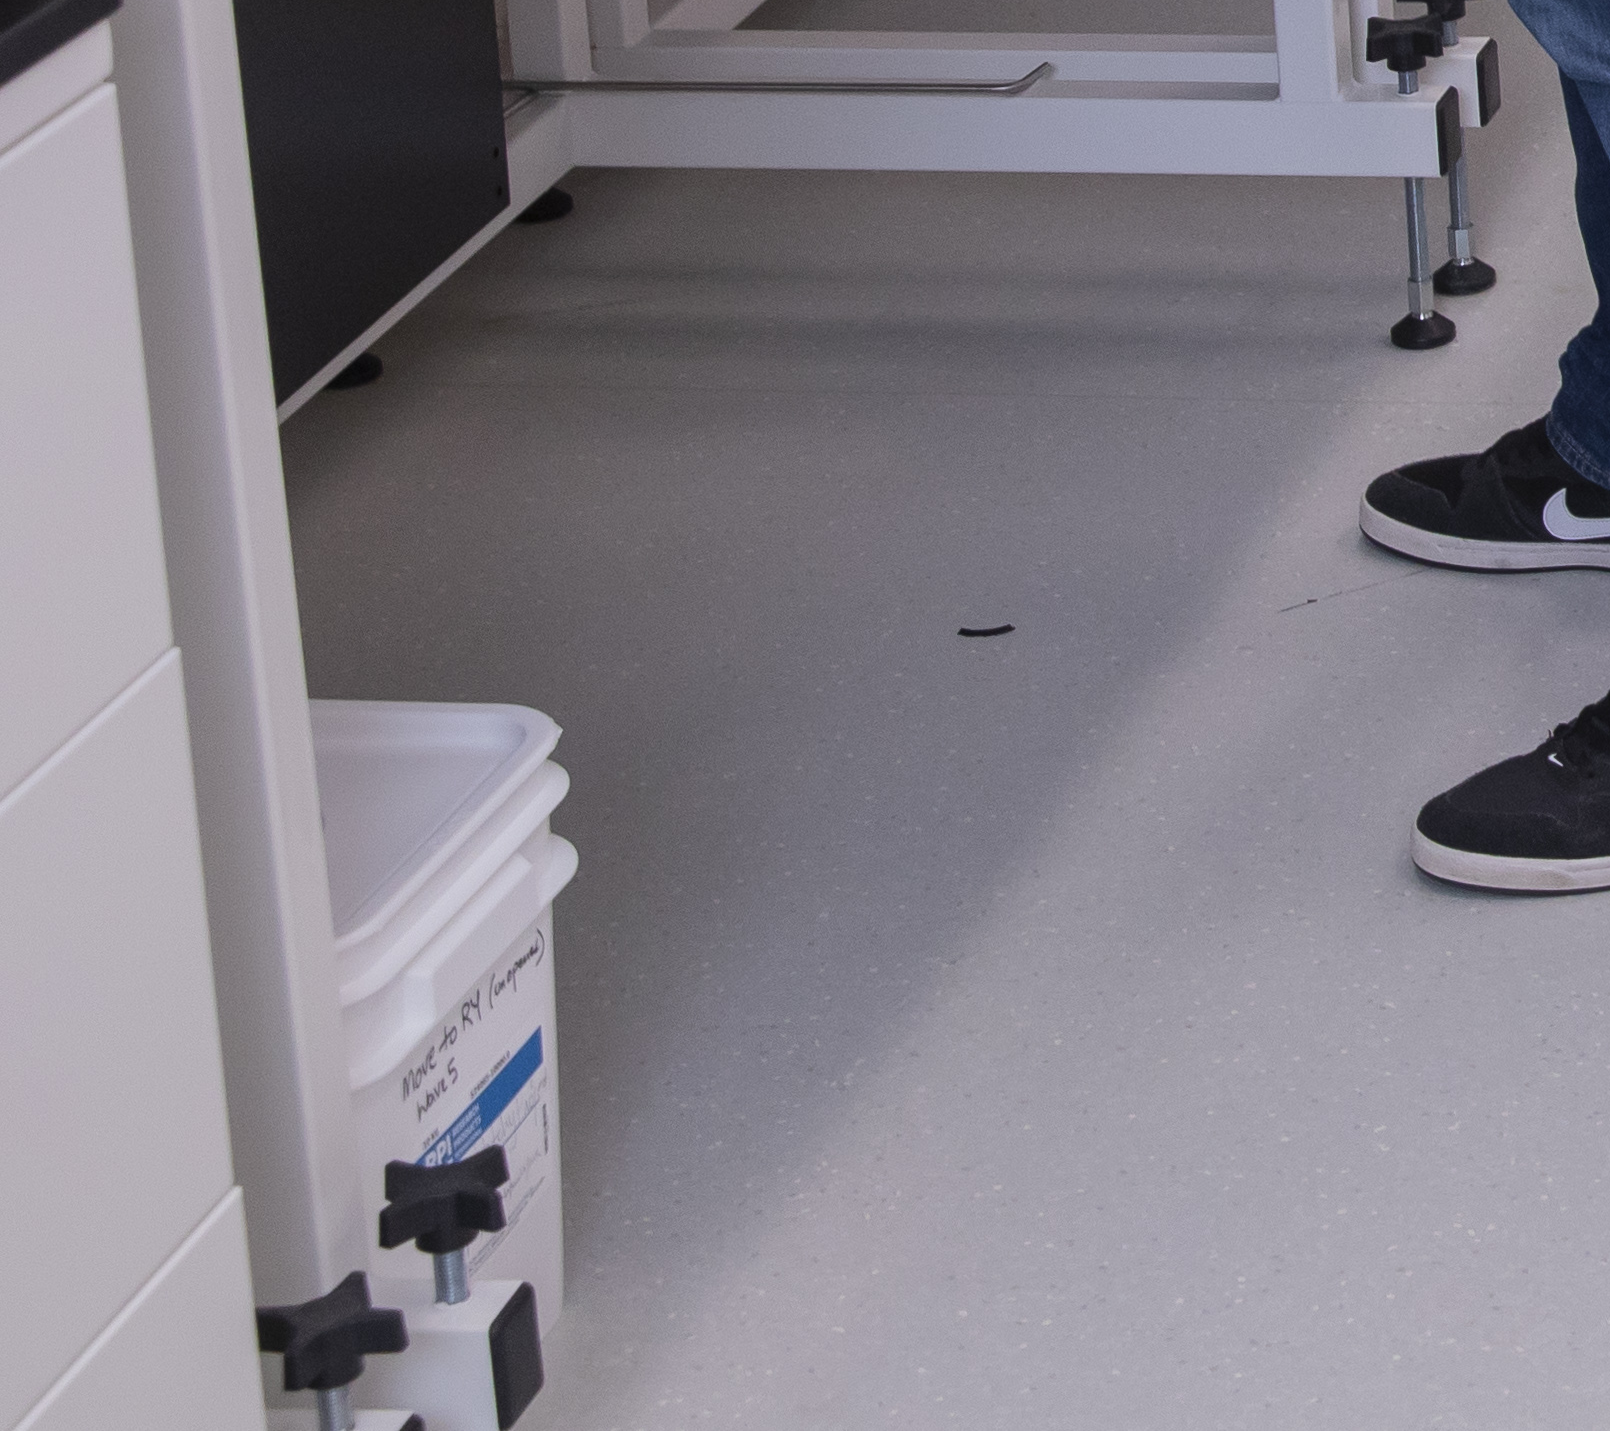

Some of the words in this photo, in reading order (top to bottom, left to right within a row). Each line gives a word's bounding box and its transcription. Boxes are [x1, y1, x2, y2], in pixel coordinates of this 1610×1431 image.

[401, 1046, 437, 1100] Move
[438, 1025, 459, 1053] to
[447, 1057, 459, 1085] 5
